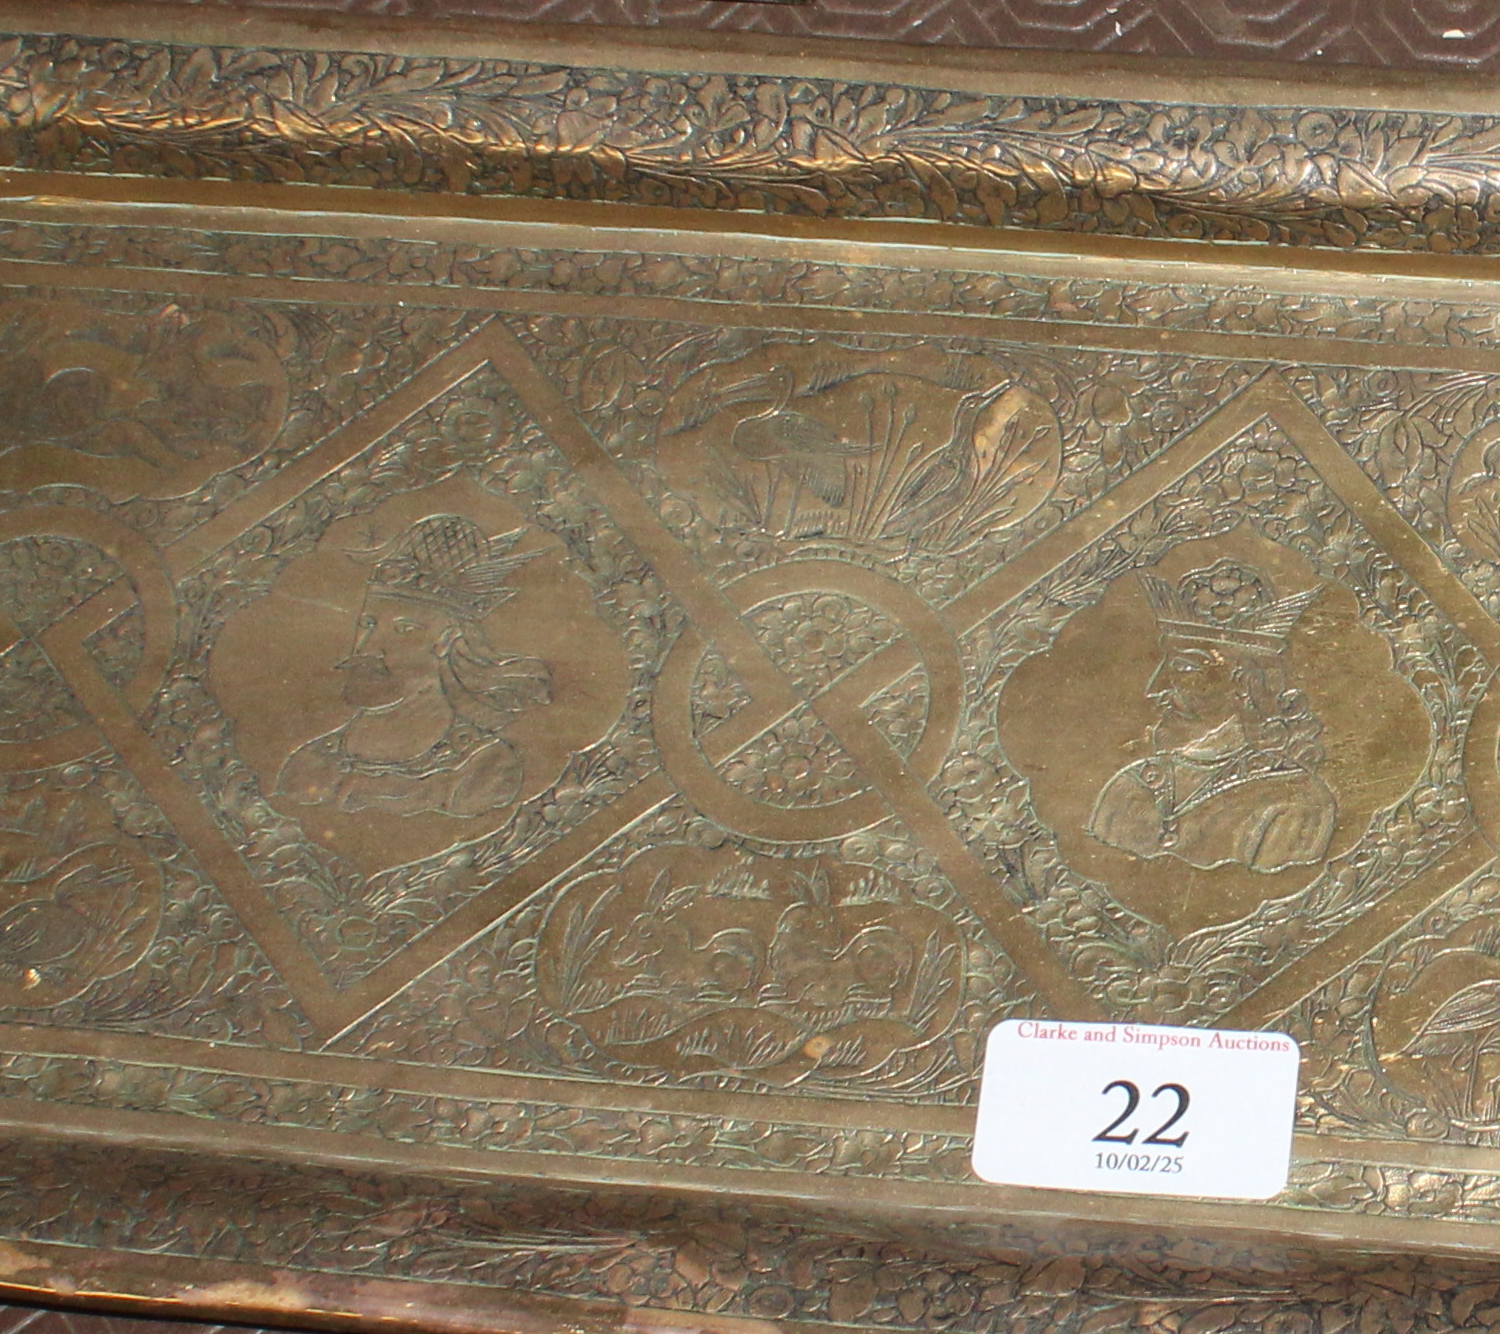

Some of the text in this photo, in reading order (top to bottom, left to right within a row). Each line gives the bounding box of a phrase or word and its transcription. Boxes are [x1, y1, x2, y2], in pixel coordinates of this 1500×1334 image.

[1016, 1020, 1290, 1052] Clarke and Simpson Auctions
[1091, 1079, 1191, 1148] 22
[1094, 1152, 1184, 1174] 10/02/25
